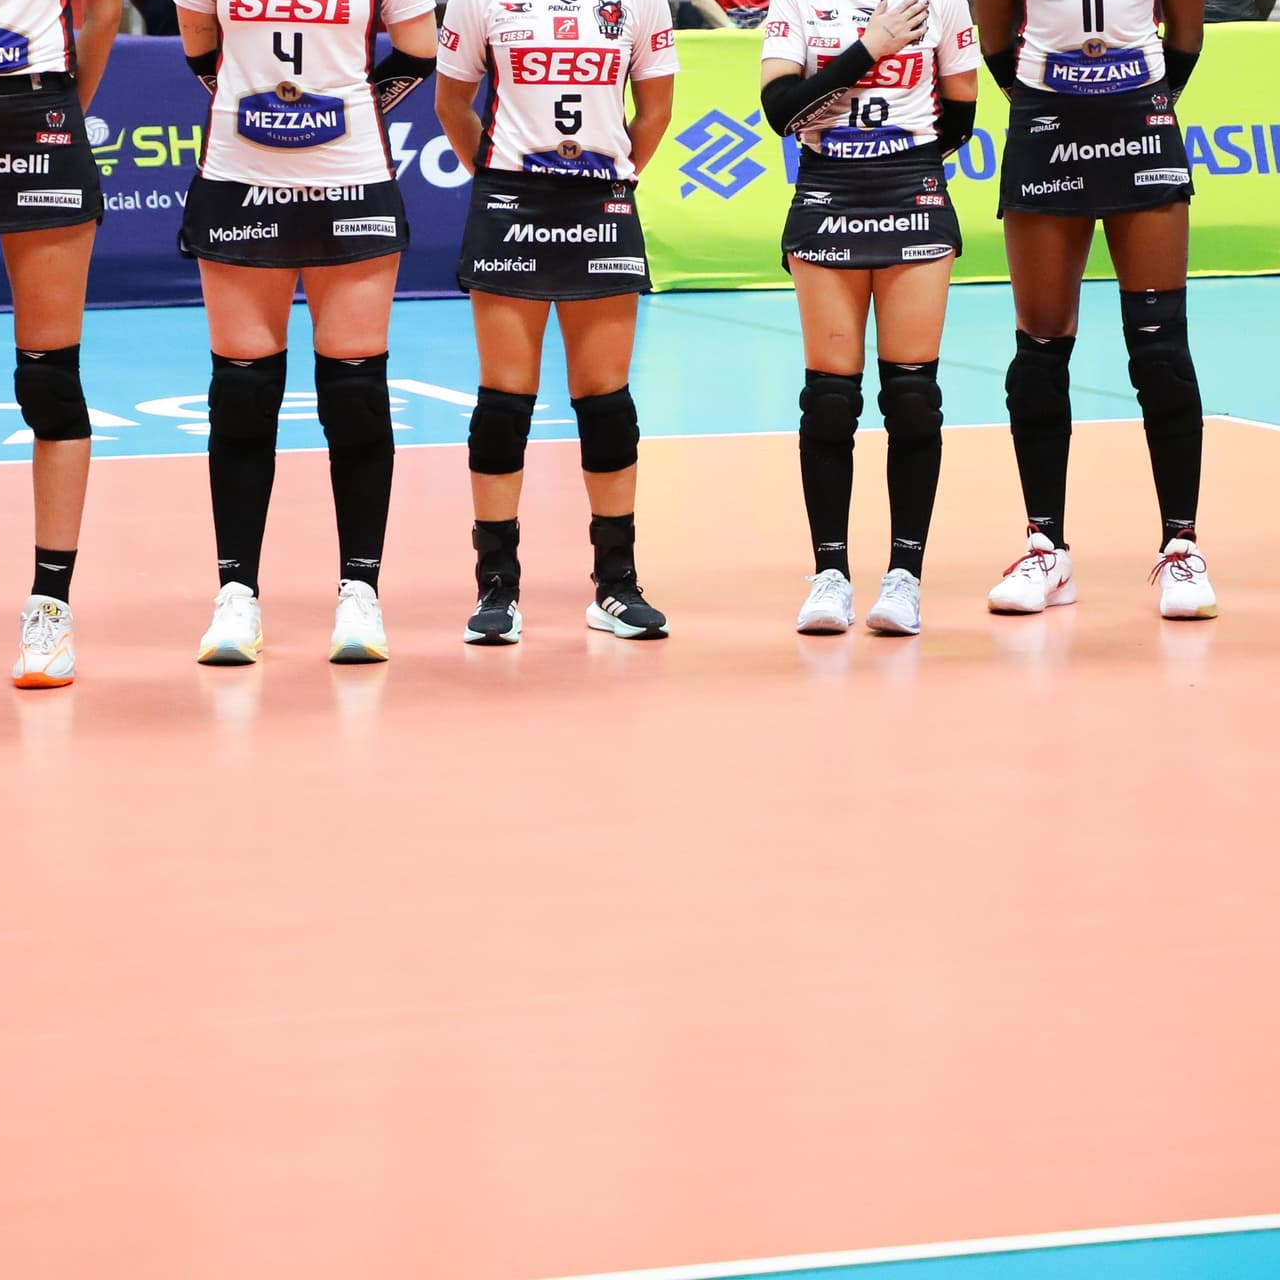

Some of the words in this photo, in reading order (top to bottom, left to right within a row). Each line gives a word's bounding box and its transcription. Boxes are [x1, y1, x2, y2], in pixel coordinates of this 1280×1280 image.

[503, 32, 530, 40] FIESP
[600, 27, 623, 35] SESI
[809, 38, 838, 46] FIESP
[273, 32, 302, 74] 4
[522, 51, 613, 81] SESI
[1052, 61, 1141, 82] MEZZANI
[245, 111, 336, 128] MEZZANI
[555, 94, 582, 135] 5
[849, 97, 888, 127] 10
[1150, 116, 1172, 124] SESI
[1031, 122, 1060, 132] PENALTY
[39, 133, 68, 143] SESI
[268, 132, 315, 141] ALIMENTOS
[828, 138, 909, 157] MEZZANI
[1050, 135, 1161, 163] Mondelli
[1022, 176, 1084, 196] Mobifácil
[19, 195, 80, 205] PERNAMBUCANAS
[145, 193, 171, 210] do
[242, 185, 364, 206] Mondelli
[919, 196, 942, 204] SESI
[608, 204, 630, 213] SESI
[335, 223, 394, 234] PERNAMBUCANAS
[818, 213, 929, 233] Mondelli
[210, 222, 278, 242] Mobifácil
[503, 223, 617, 242] Mondelli
[474, 257, 536, 272] Mobifácil
